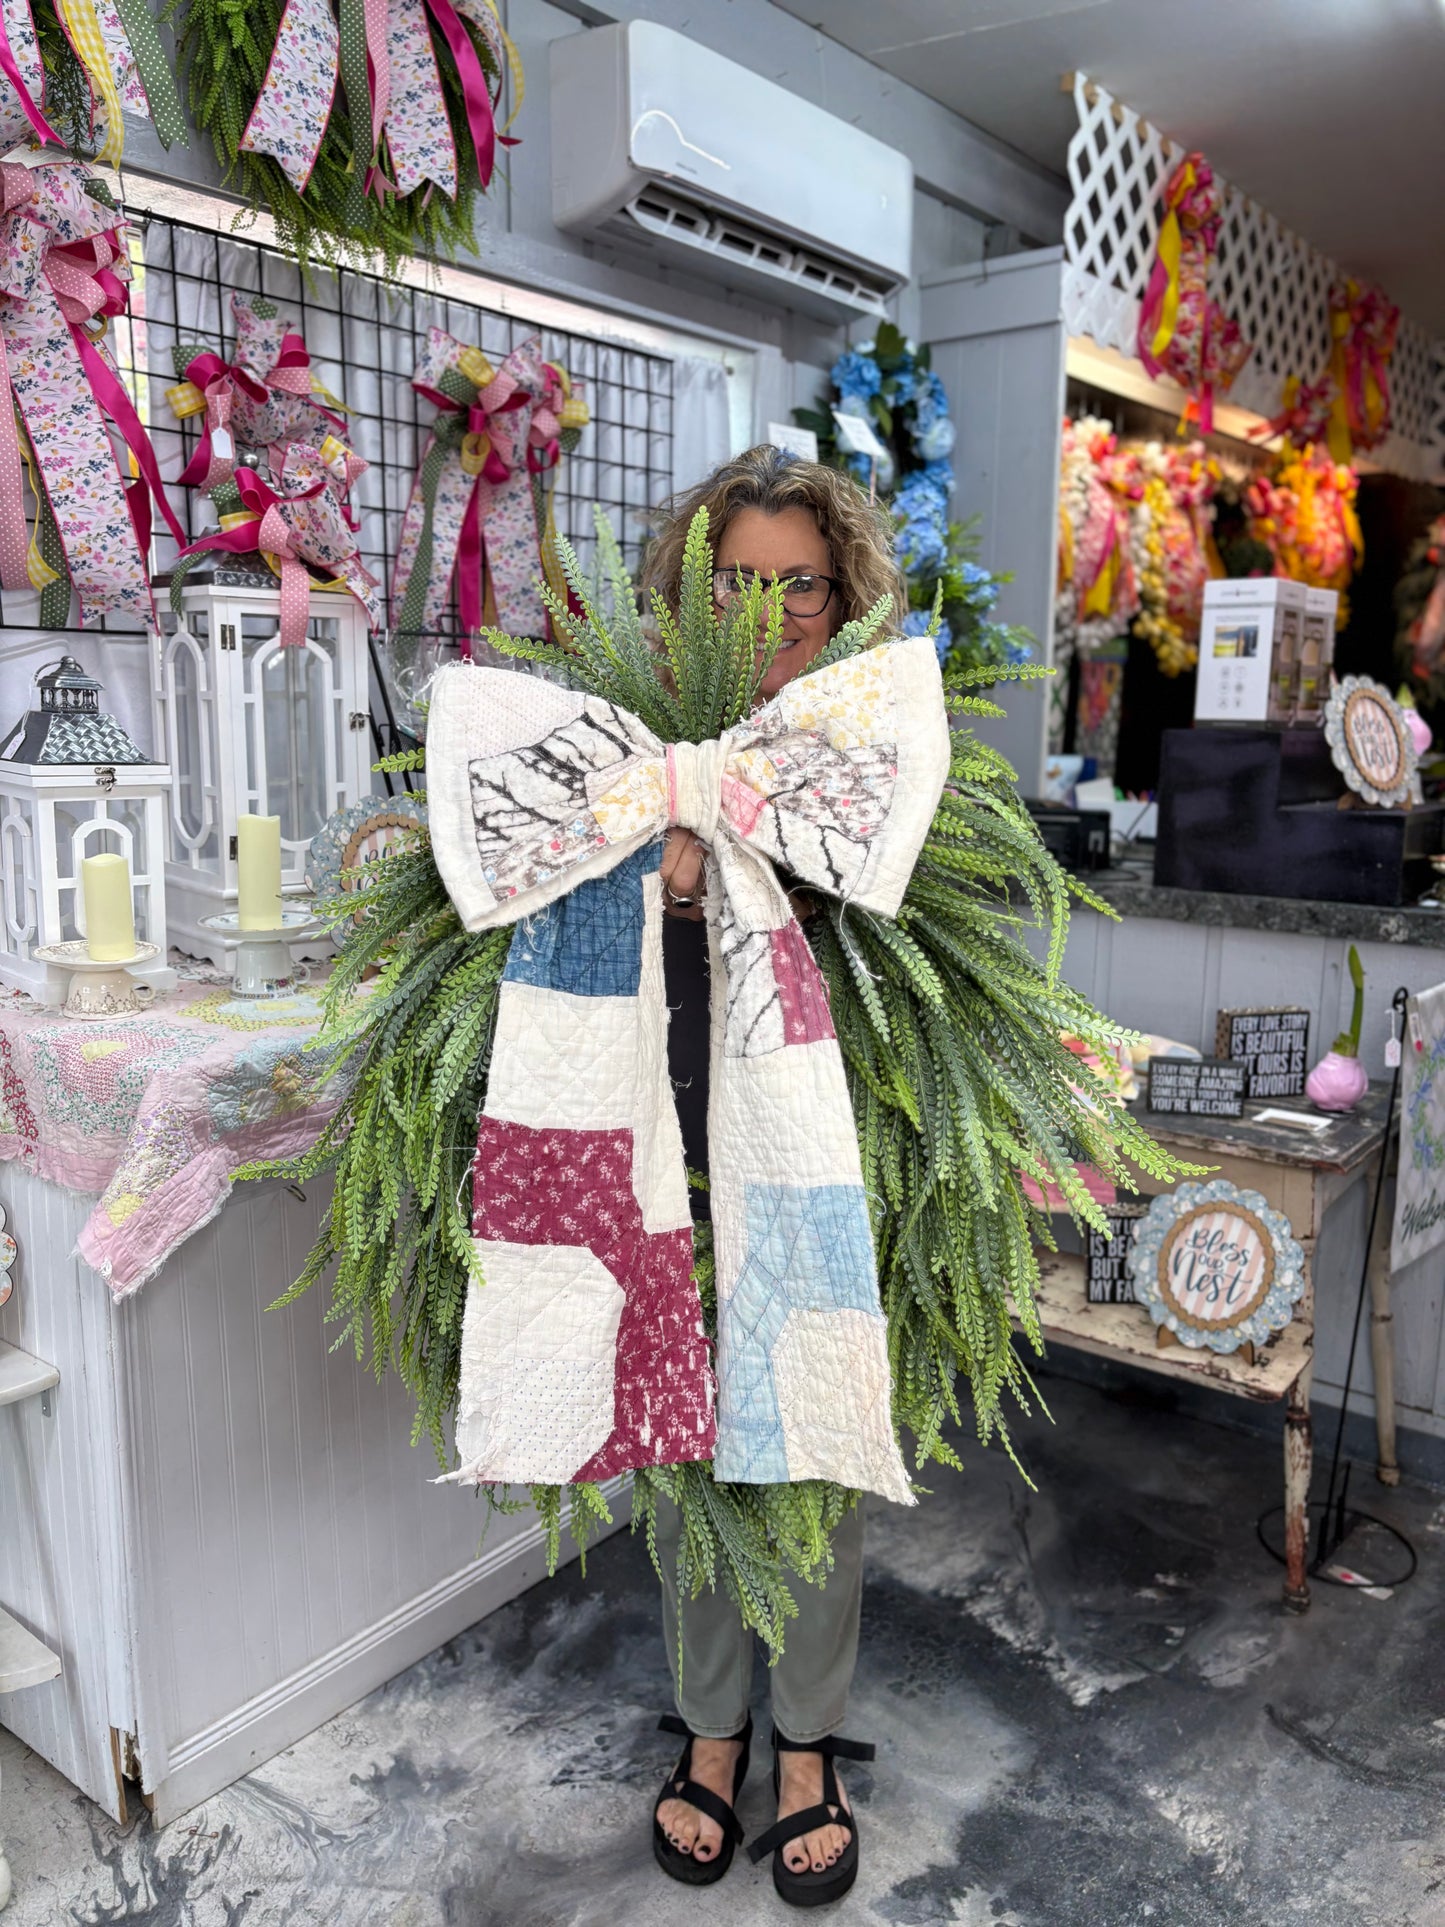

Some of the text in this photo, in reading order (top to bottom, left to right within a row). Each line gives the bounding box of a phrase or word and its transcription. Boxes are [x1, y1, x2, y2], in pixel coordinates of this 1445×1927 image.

[1232, 1014, 1308, 1033] EVERY LOVE STORY
[1231, 1031, 1305, 1055] IS BEAUTIFUL
[1152, 1063, 1178, 1075] EVERY
[1211, 1066, 1217, 1077] A
[1218, 1067, 1244, 1079] WHILE
[1257, 1053, 1288, 1075] OURS
[1290, 1052, 1304, 1073] IS
[1152, 1075, 1244, 1092] SOMEONE AMAZING
[1152, 1087, 1177, 1098] COMES
[1178, 1088, 1197, 1099] INTO
[1249, 1073, 1304, 1097] FAVORITE
[1151, 1097, 1242, 1115] YOU'RE WELCOME
[1089, 1235, 1105, 1257] IS
[1185, 1228, 1250, 1266] Bless
[1092, 1258, 1121, 1280] BUT
[1173, 1247, 1253, 1305] Nest
[1089, 1280, 1134, 1302] MY FA
